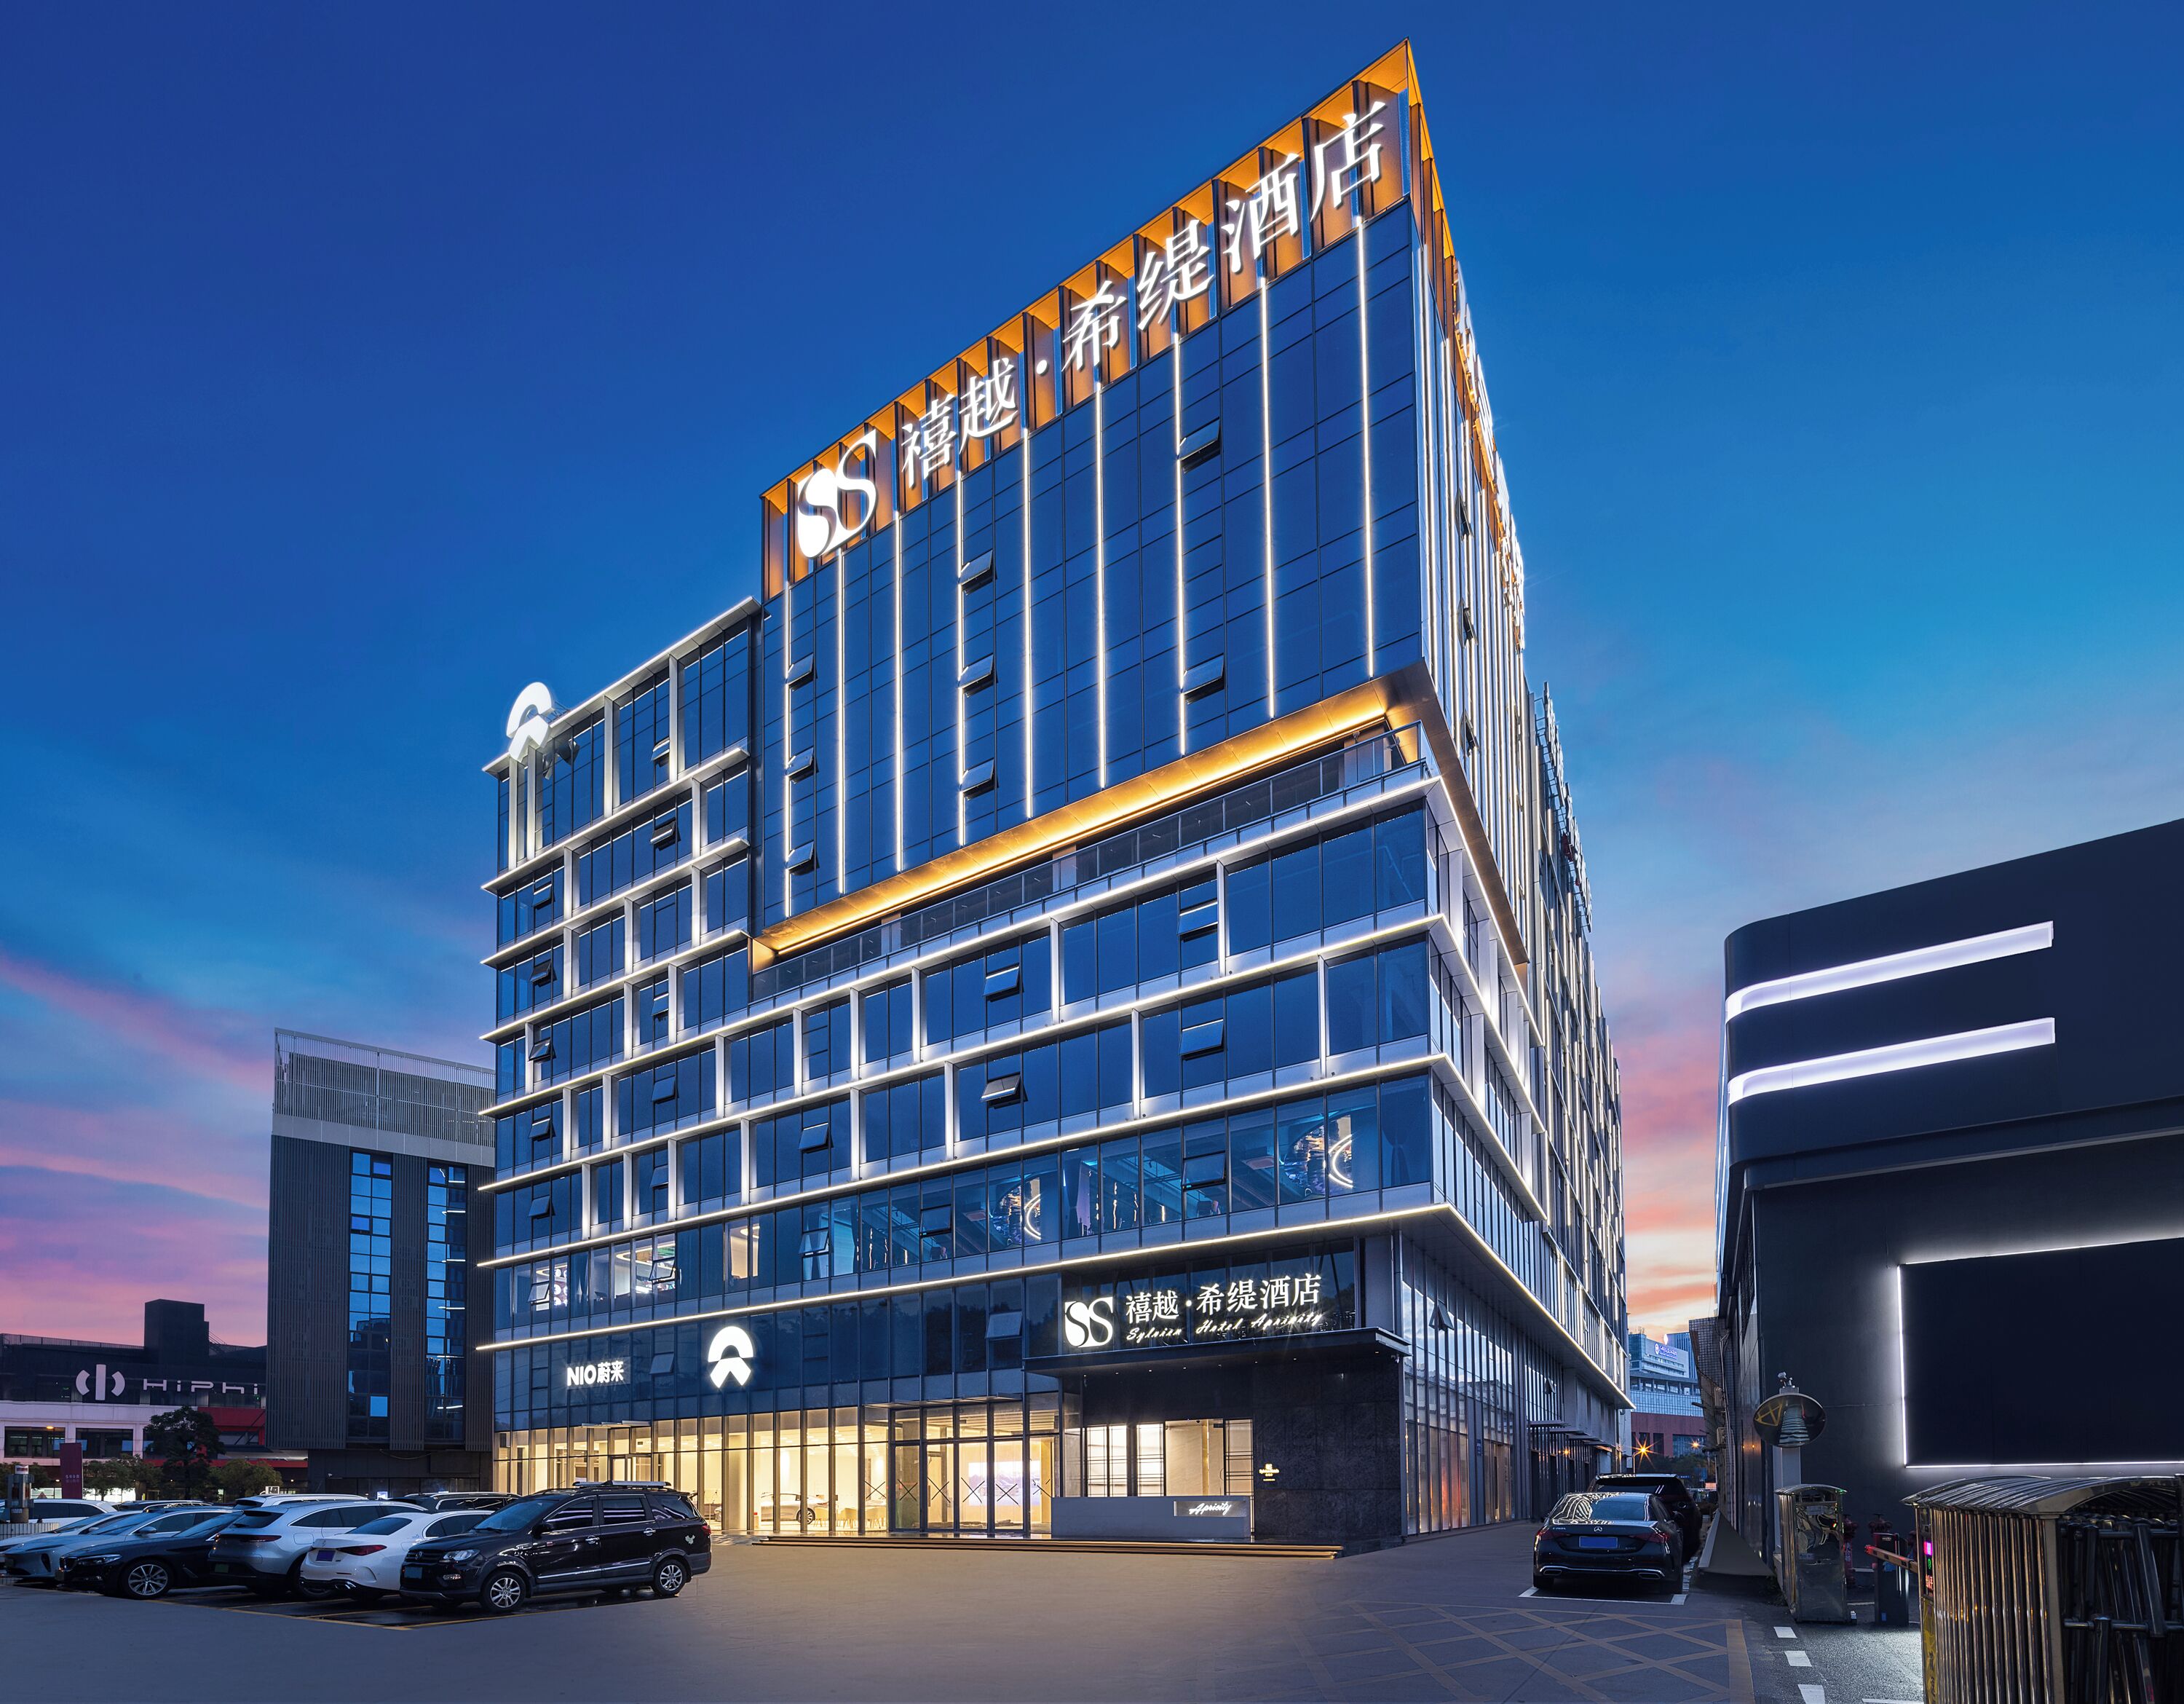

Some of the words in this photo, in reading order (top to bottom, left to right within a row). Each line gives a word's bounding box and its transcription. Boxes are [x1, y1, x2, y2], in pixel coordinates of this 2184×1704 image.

[901, 101, 1386, 489] 禧越·希缇酒店
[1125, 1273, 1322, 1324] 禧越·希缇酒店
[1196, 1318, 1243, 1335] Hotel
[143, 1378, 258, 1395] HiPhi
[1189, 1502, 1232, 1515] Apricity
